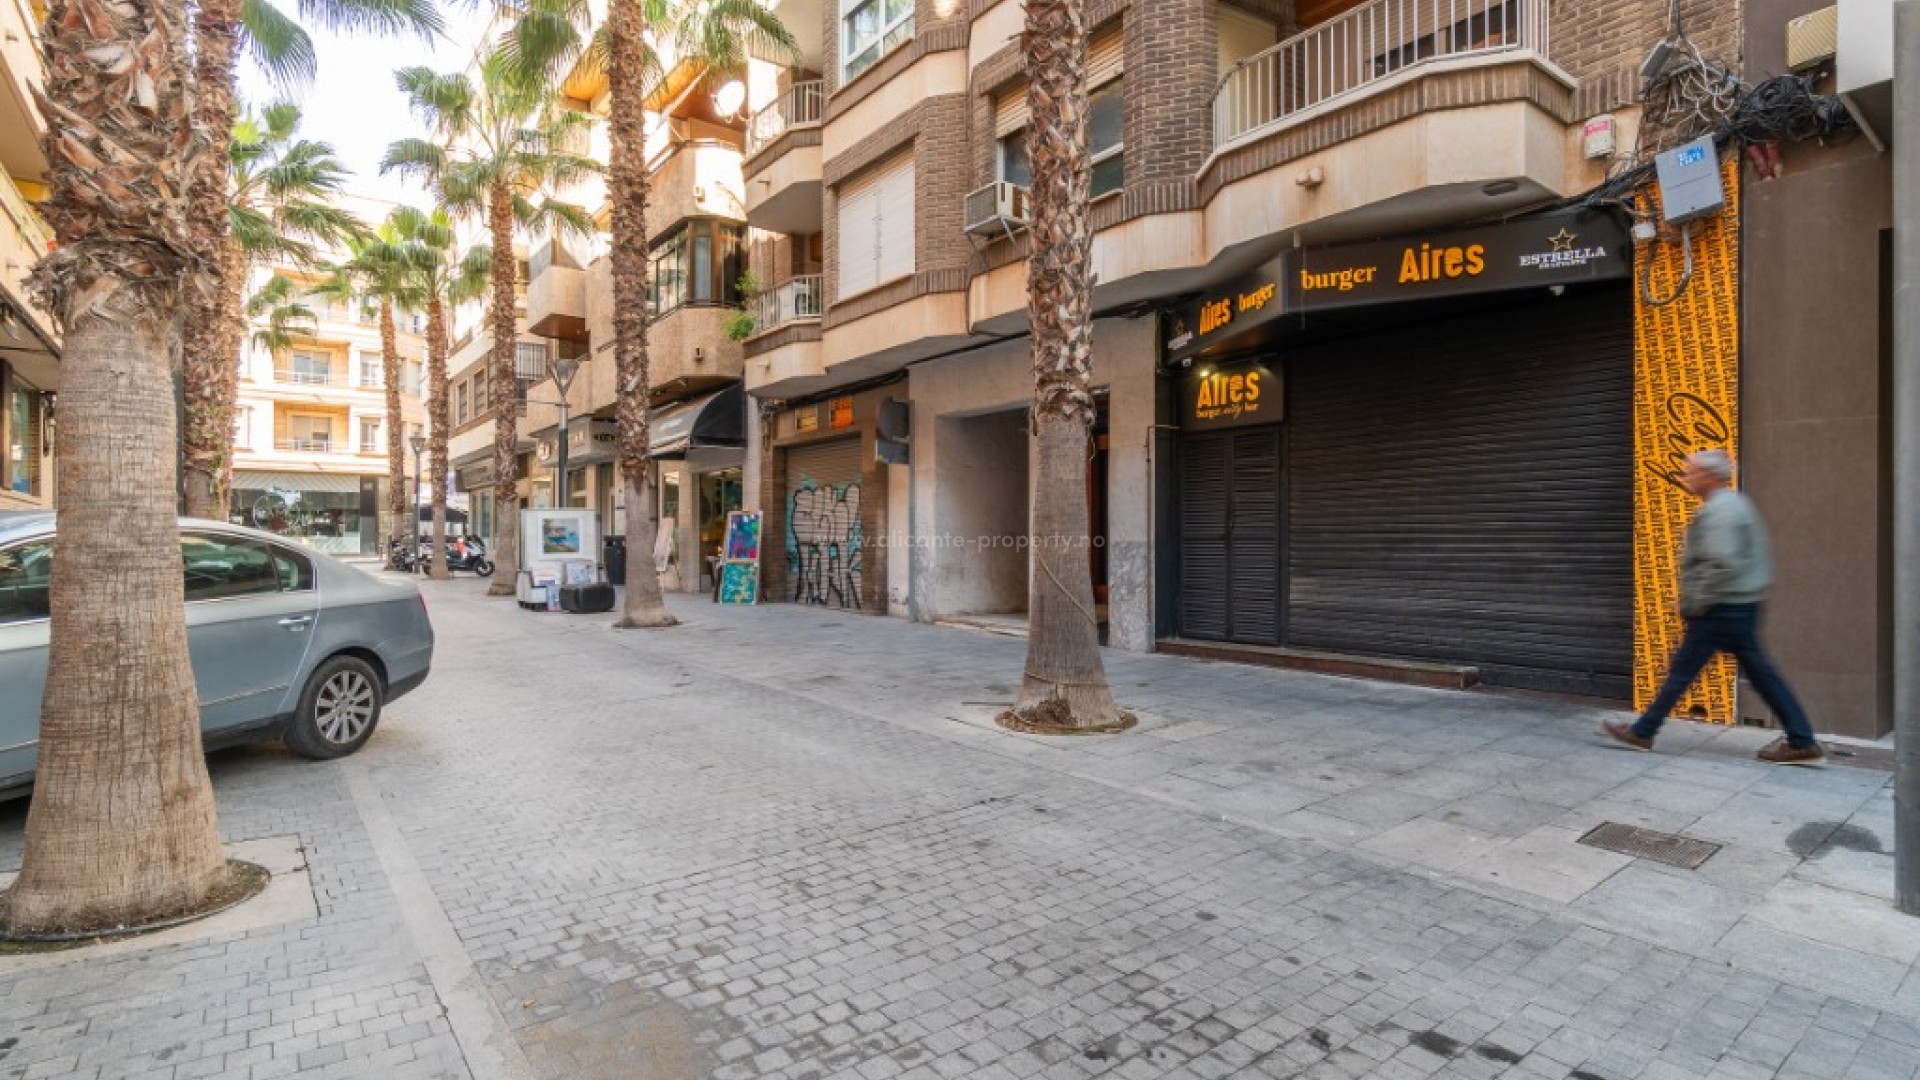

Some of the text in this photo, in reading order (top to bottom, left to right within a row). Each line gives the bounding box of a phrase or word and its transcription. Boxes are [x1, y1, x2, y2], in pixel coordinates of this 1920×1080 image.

[1300, 242, 1485, 291] burger Aires
[1519, 246, 1607, 266] ESTRELLA
[1199, 283, 1276, 335] Aires burger
